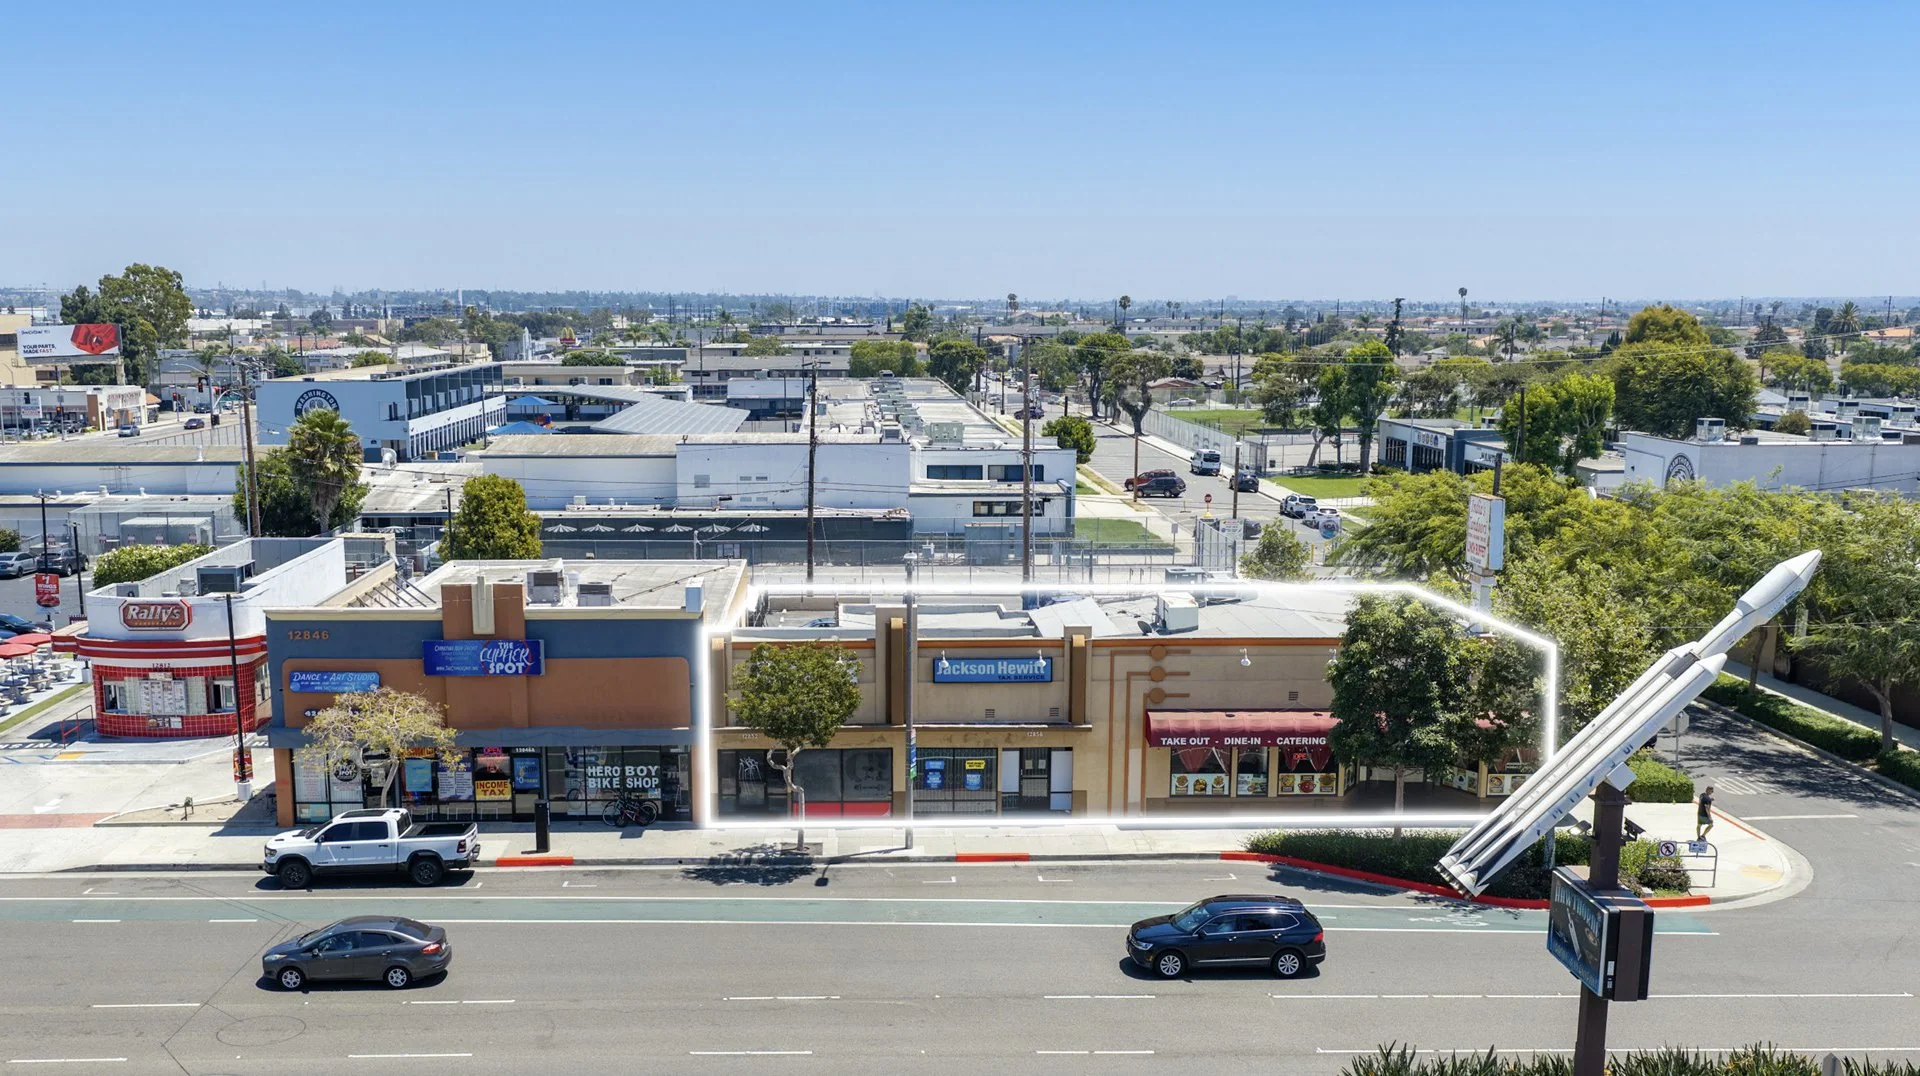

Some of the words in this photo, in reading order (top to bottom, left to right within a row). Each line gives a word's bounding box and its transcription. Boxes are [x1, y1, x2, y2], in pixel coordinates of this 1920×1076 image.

[296, 390, 338, 409] WASHINGTON
[288, 630, 329, 640] 12846
[498, 642, 514, 650] THE
[480, 648, 534, 665] CYPHER
[489, 662, 525, 674] SPOT
[998, 661, 1045, 674] Hewitt
[293, 672, 321, 681] DANCE
[329, 673, 345, 681] ART
[347, 672, 376, 682] STUDIO
[588, 766, 620, 776] HERO
[625, 766, 659, 776] BOY
[476, 782, 508, 790] INCOME
[588, 778, 620, 788] BIKE
[626, 778, 659, 788] SHOP
